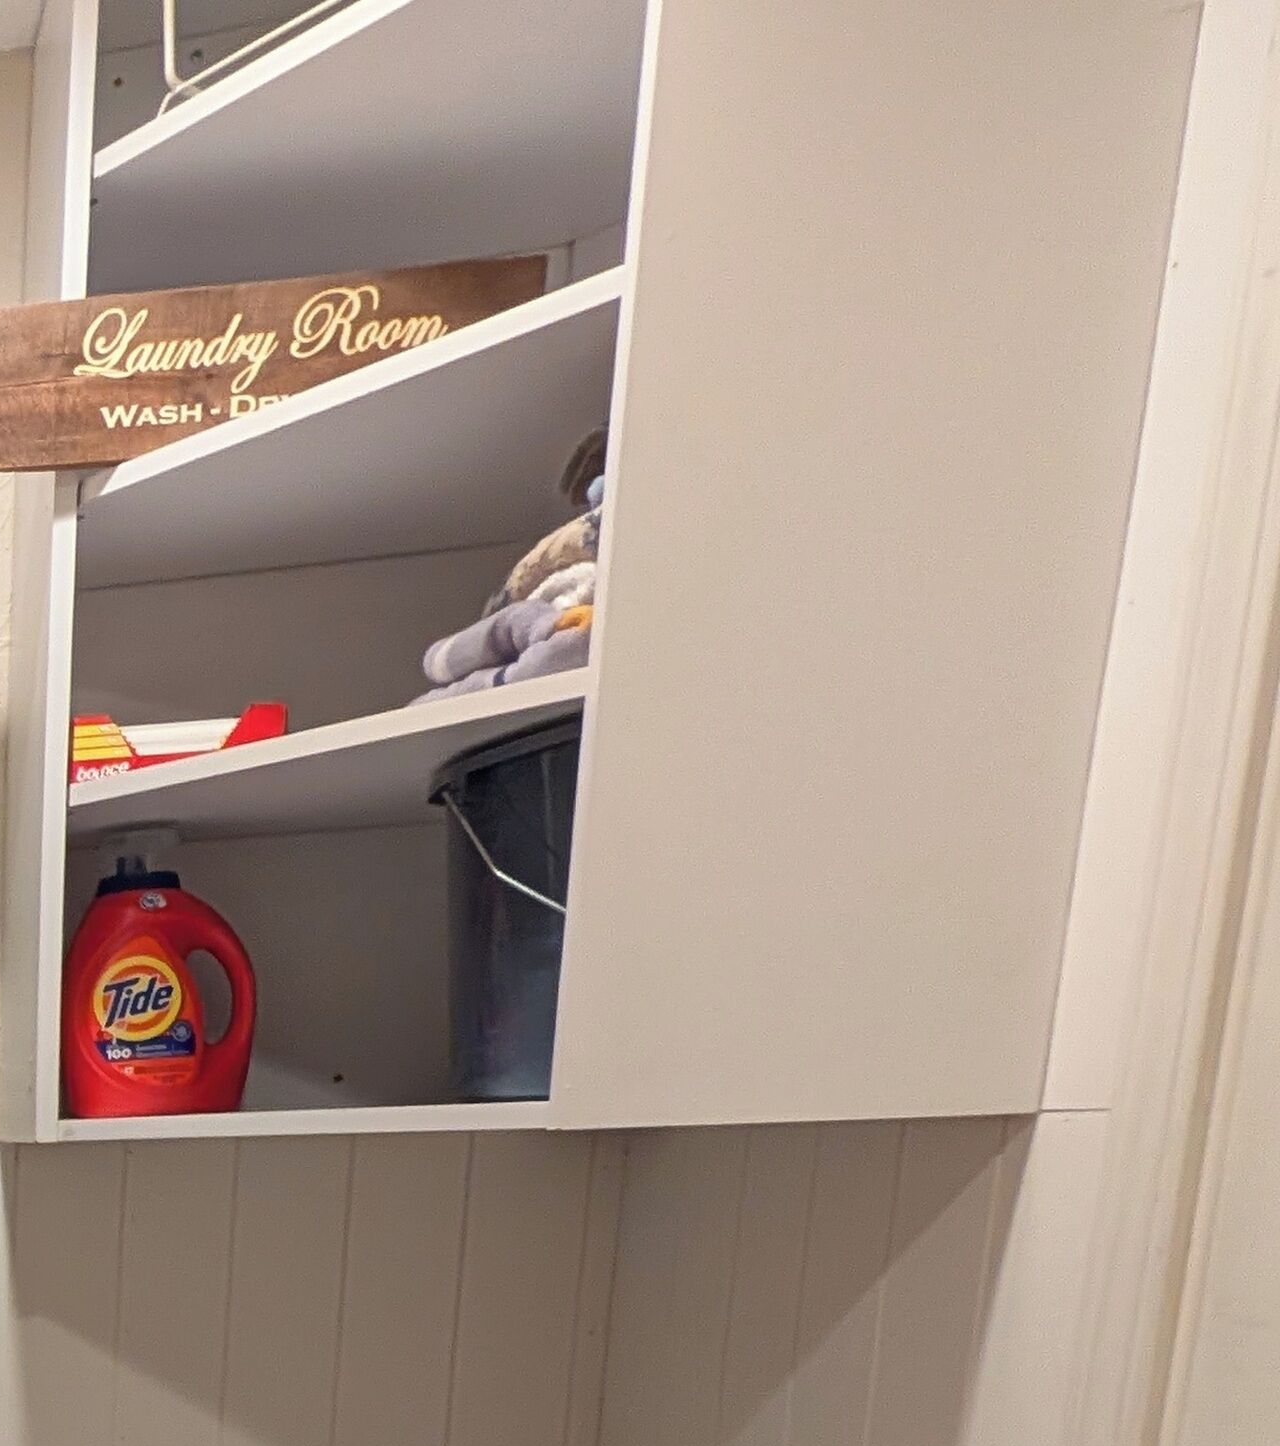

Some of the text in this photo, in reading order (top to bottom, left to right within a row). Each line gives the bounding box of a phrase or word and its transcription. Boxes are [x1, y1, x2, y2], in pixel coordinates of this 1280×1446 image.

[74, 285, 447, 393] Laundry Room
[99, 402, 204, 429] WASH
[103, 976, 175, 1028] Tide
[106, 1048, 132, 1060] 100
